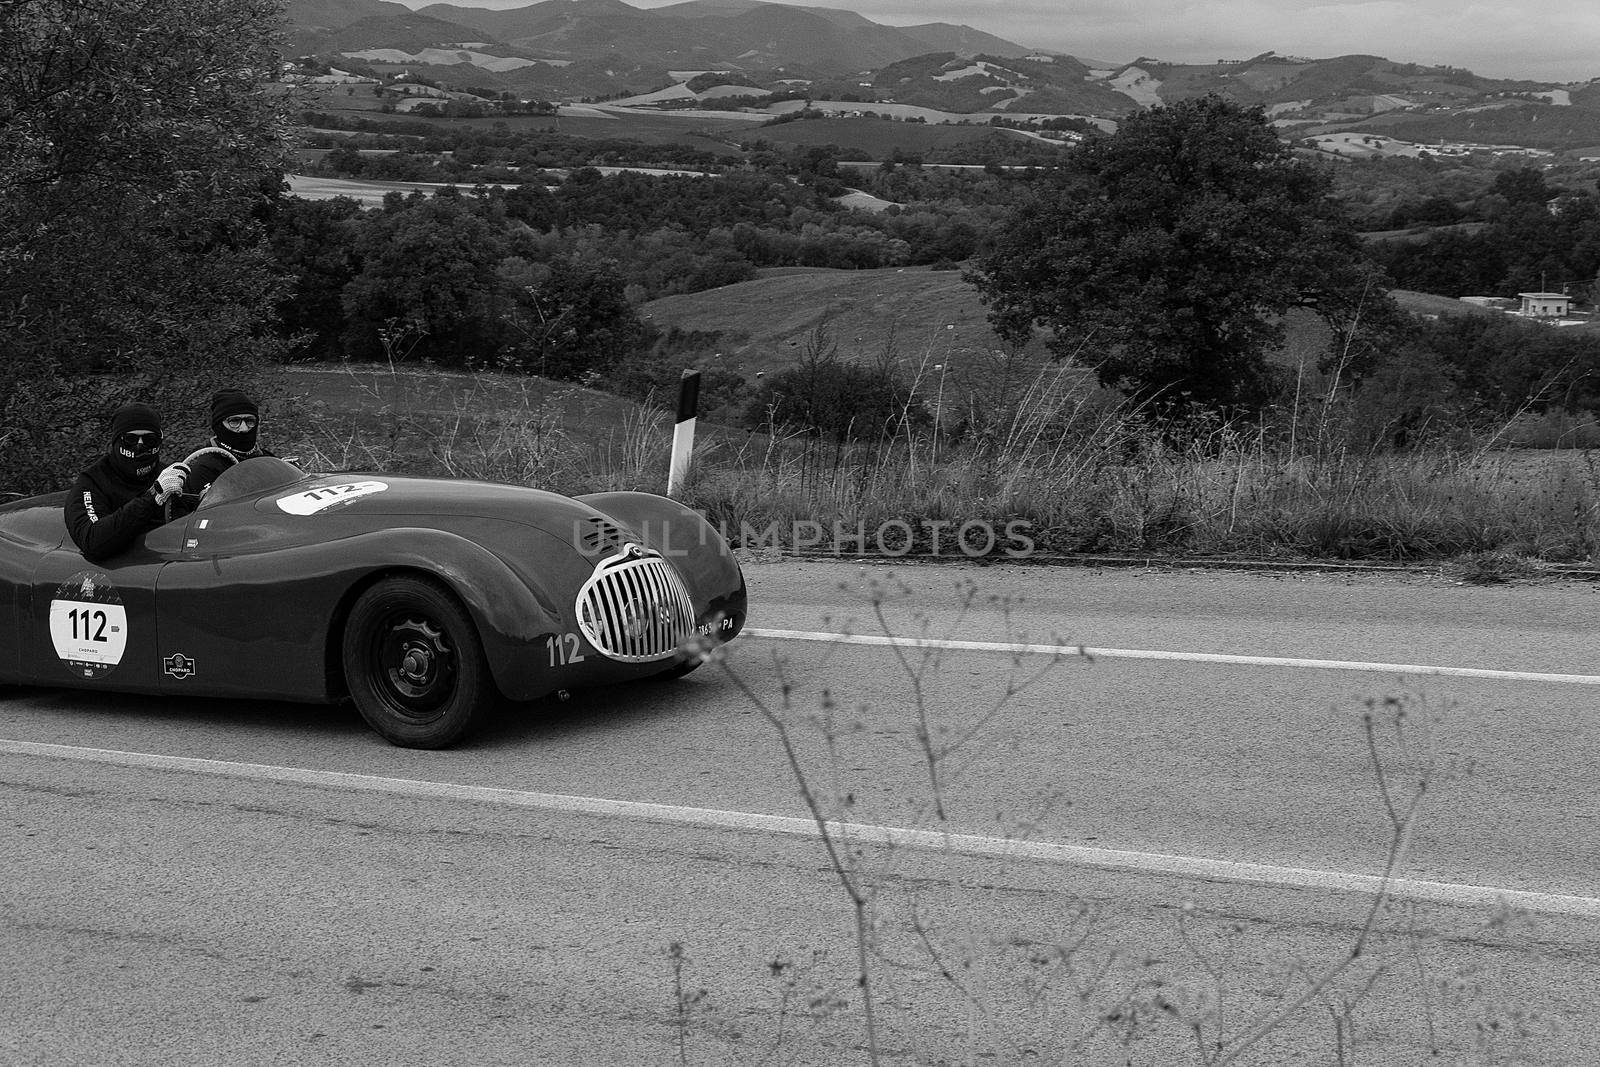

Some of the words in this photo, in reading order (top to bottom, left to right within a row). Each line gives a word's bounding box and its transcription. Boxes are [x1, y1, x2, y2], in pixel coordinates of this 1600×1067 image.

[303, 485, 362, 500] 112
[68, 608, 108, 642] 112
[546, 632, 585, 667] 112
